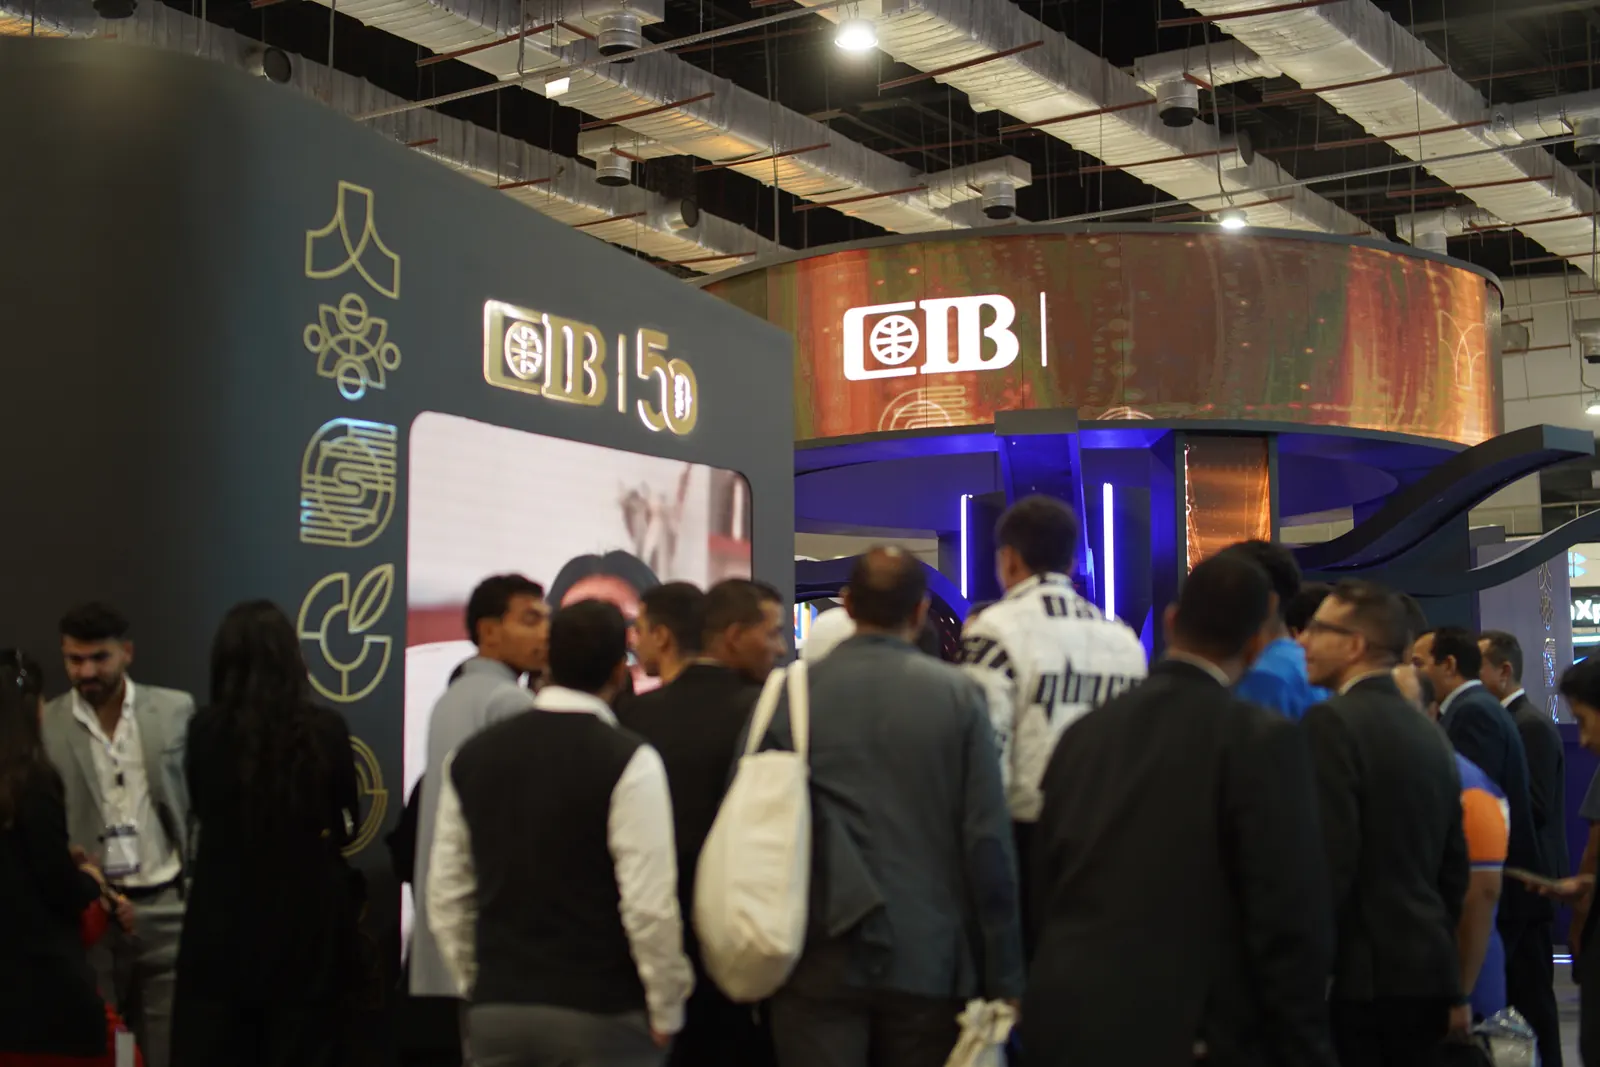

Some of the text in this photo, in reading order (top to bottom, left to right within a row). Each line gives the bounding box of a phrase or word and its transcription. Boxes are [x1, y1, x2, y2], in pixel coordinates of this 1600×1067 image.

[484, 299, 607, 406] CIB
[637, 328, 698, 435] 50
[843, 294, 1019, 381] CIB
